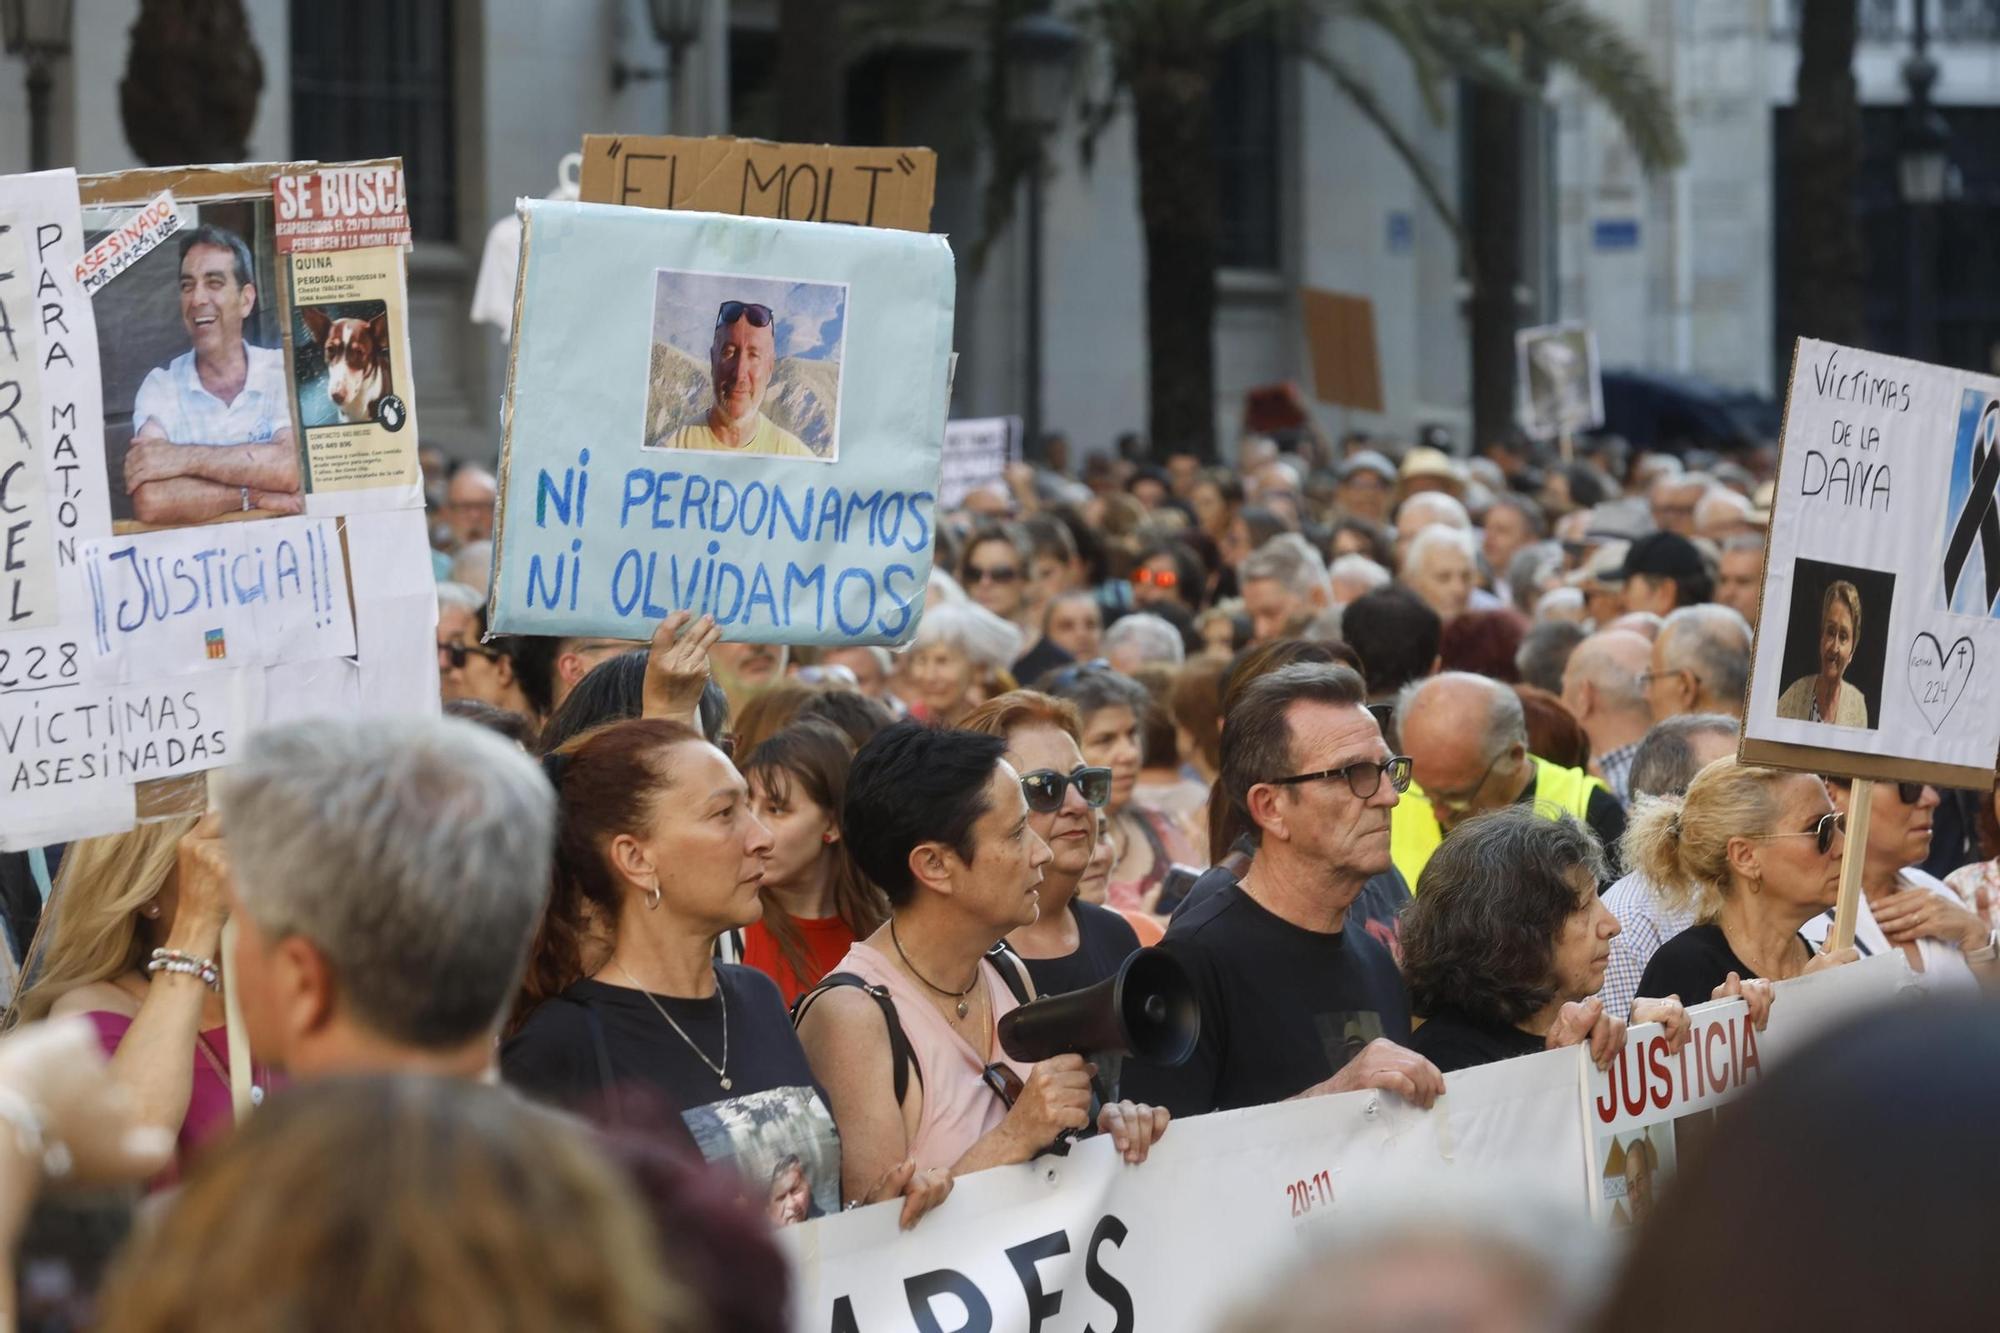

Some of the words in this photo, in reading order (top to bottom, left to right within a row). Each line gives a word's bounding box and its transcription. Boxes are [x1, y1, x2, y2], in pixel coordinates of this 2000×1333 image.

[278, 176, 313, 219] SE
[741, 152, 917, 227] MOLT"
[75, 201, 170, 283] ASESINADO
[295, 256, 333, 271] QUINA
[37, 223, 74, 370] PARA
[83, 268, 111, 293] POR
[296, 274, 336, 286] PERDIDA
[1832, 419, 1853, 447] DE
[1860, 426, 1880, 452] LA
[52, 402, 82, 567] MATÓN
[620, 468, 935, 554] PERDONAMOS
[1801, 450, 1891, 512] DANA
[611, 540, 917, 638] OLVIDAMOS
[0, 642, 78, 687] 228
[1923, 680, 1948, 705] 224
[11, 730, 226, 792] ASESINADAS
[1596, 1013, 1762, 1124] JUSTICIA
[1286, 1169, 1335, 1219] 20:11
